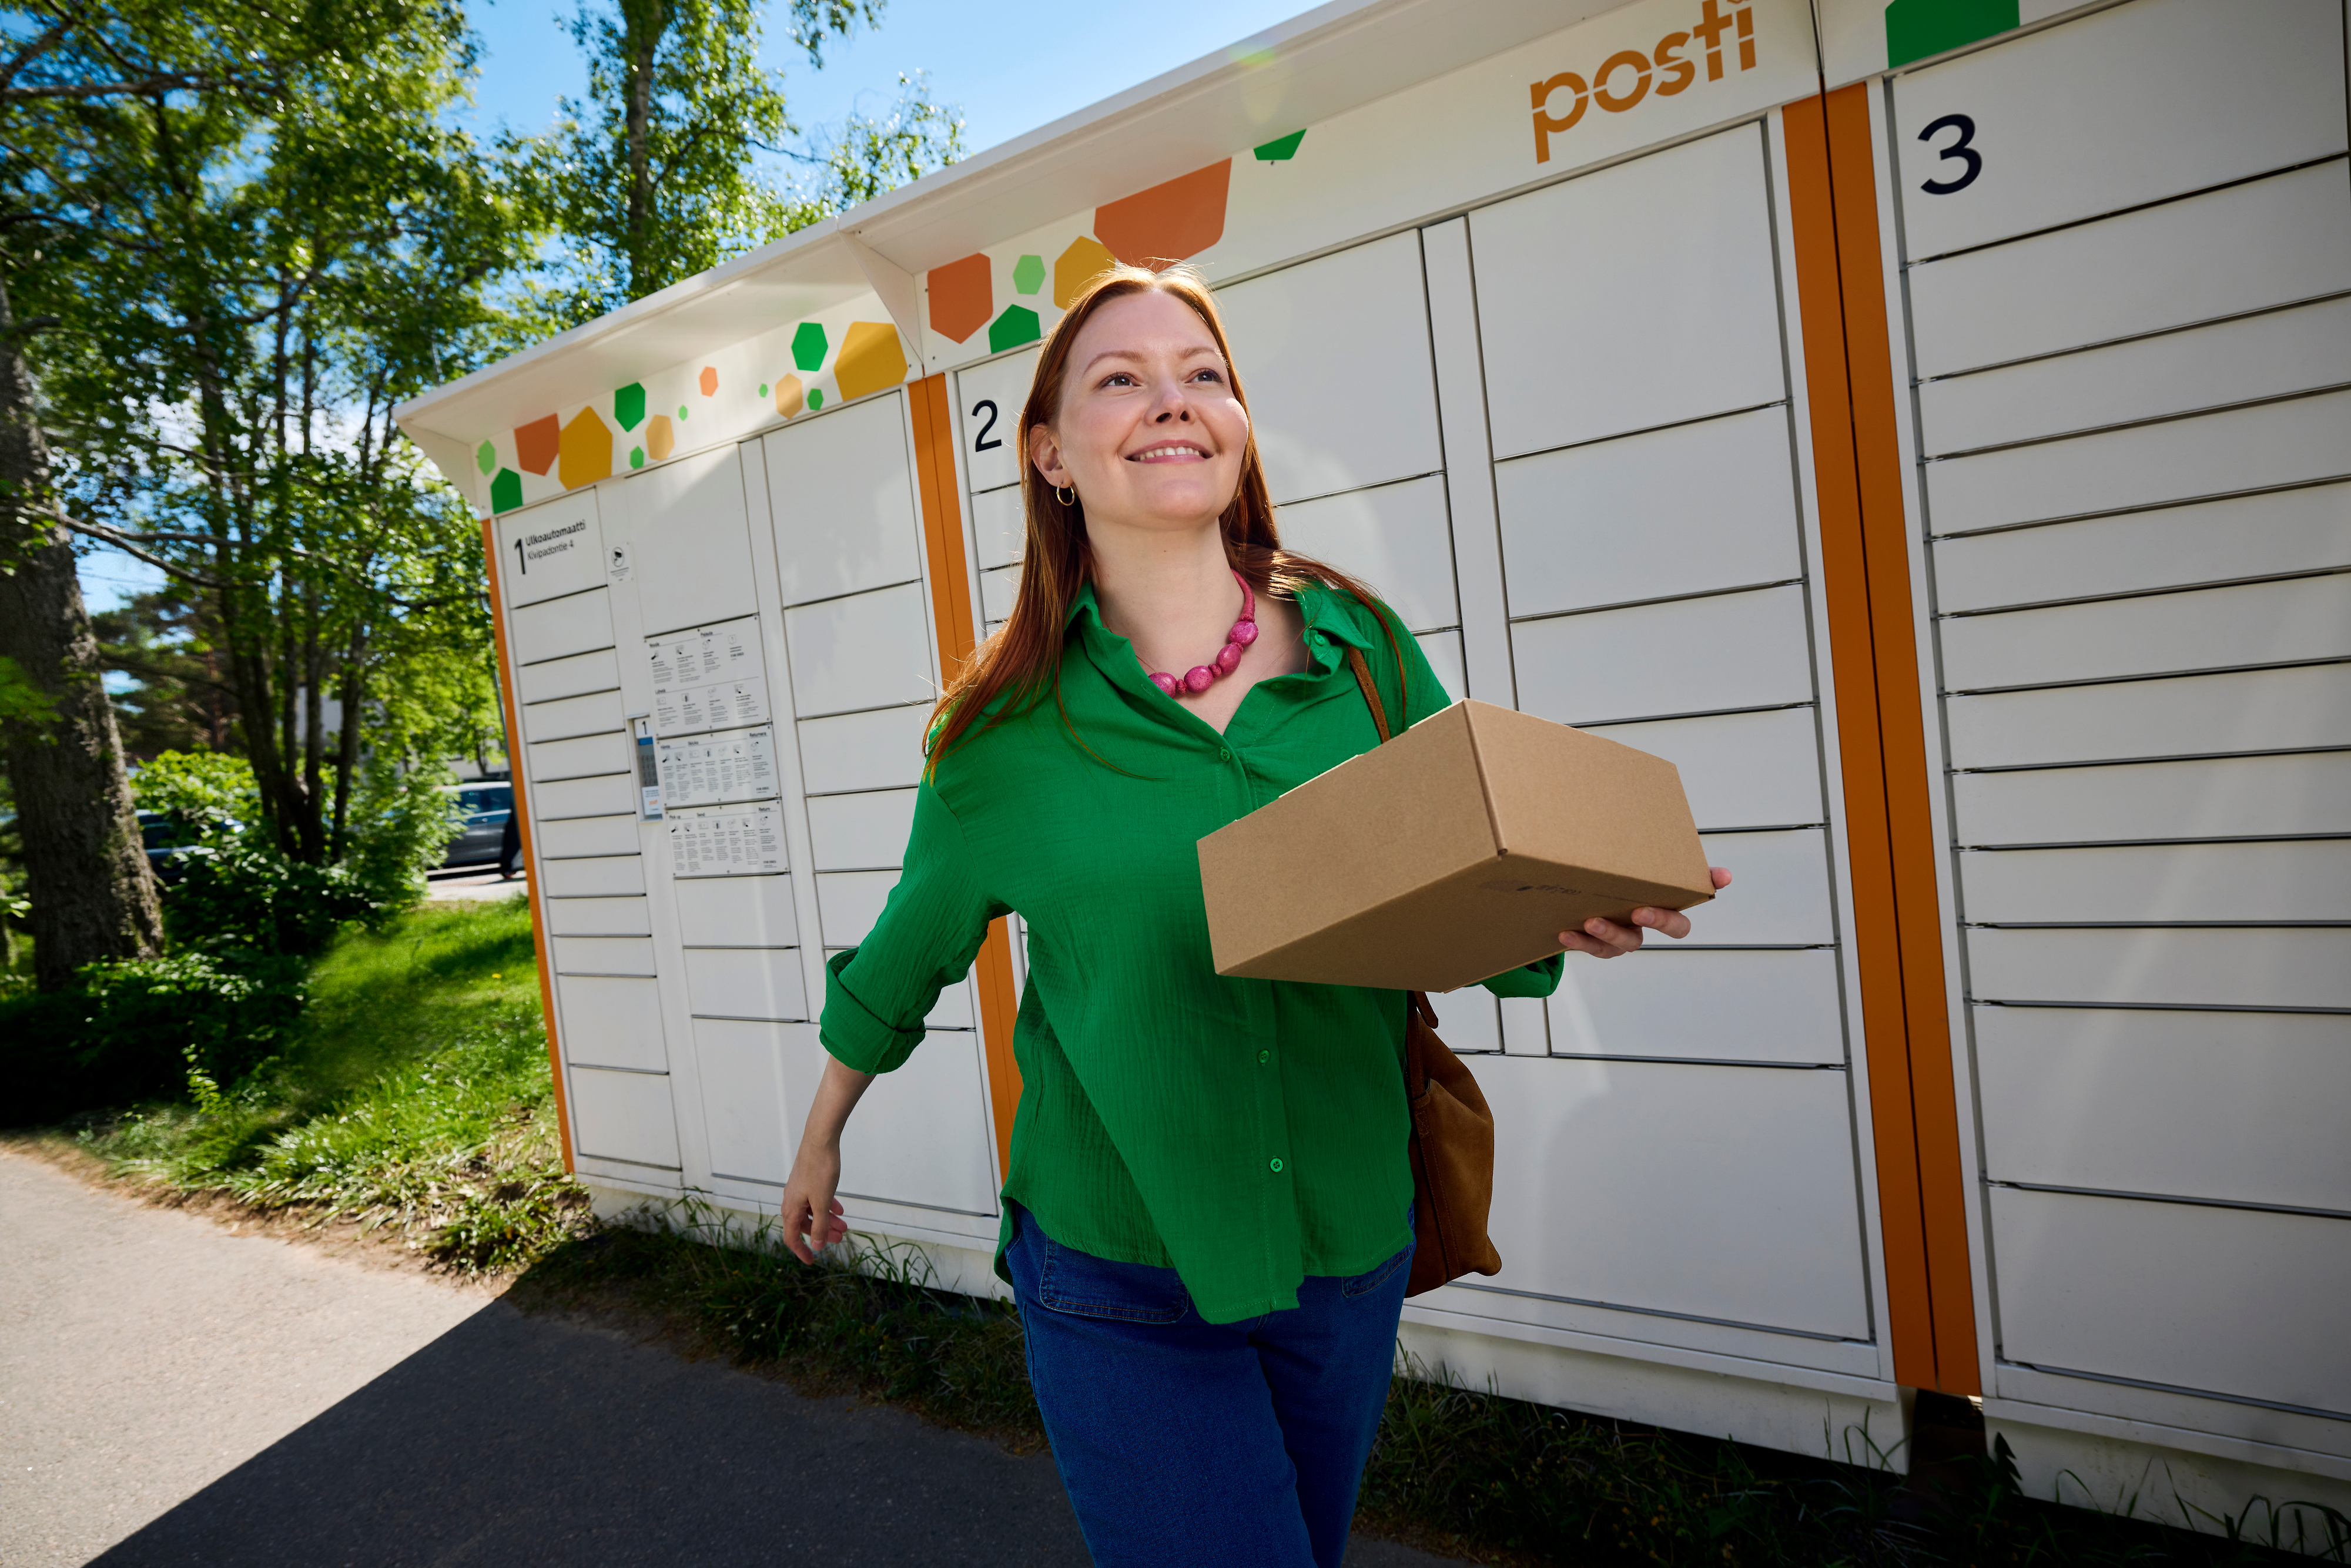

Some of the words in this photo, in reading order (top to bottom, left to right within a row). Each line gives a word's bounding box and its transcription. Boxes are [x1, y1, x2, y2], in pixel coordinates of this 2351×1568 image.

[1530, 0, 1756, 165] posti
[1918, 113, 1982, 195] 3
[972, 399, 1002, 453] 2
[525, 518, 586, 547] Ulkoautomaatti
[527, 541, 567, 561] Kivipadontie
[568, 539, 574, 548] 4
[514, 538, 525, 575] 1
[642, 720, 647, 735] 1
